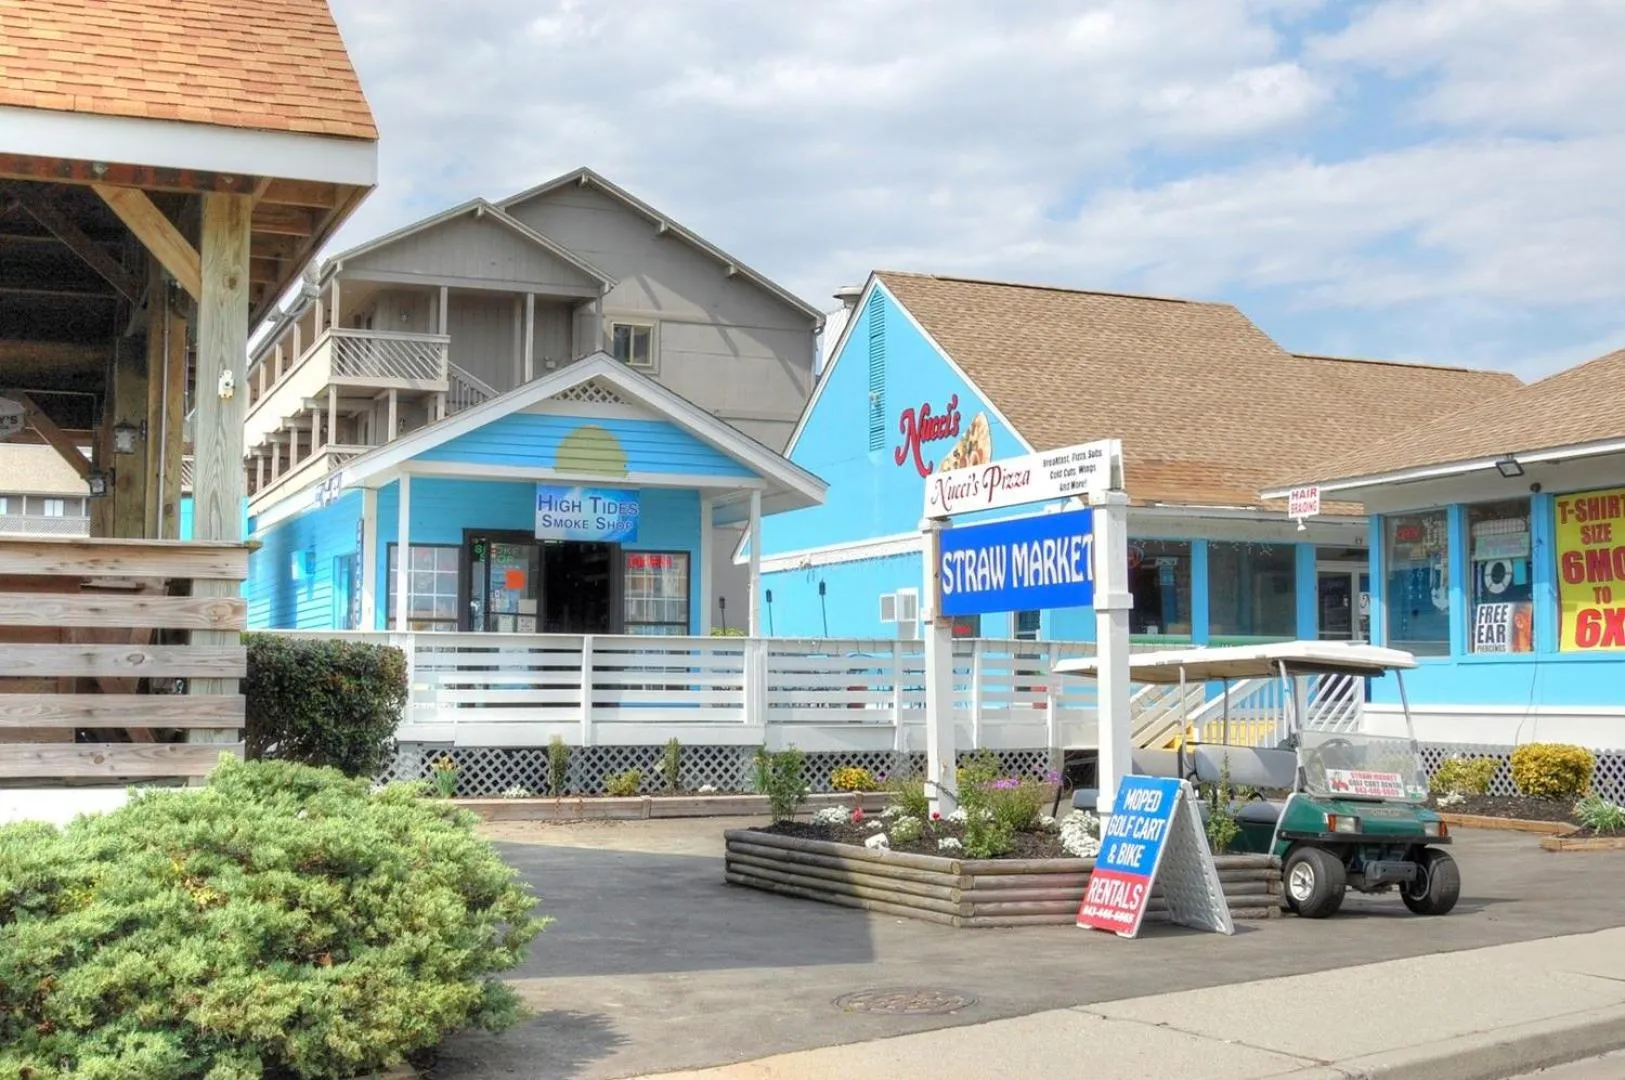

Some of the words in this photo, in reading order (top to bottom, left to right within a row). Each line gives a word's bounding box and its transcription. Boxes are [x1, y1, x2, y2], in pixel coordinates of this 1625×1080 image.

[894, 393, 961, 479] Nucci's
[930, 472, 980, 512] Nucci's
[982, 465, 1031, 503] Pizza
[1291, 487, 1317, 499] HAIR
[538, 494, 582, 513] HIGH
[589, 496, 639, 516] TIDES
[542, 514, 588, 529] SMOKE
[595, 517, 632, 530] SHOP
[1580, 522, 1612, 546] SIZE
[942, 544, 1007, 595] STRAW
[1012, 533, 1093, 588] MARKET
[1592, 585, 1612, 605] TO
[1478, 604, 1509, 624] FREE
[1477, 624, 1506, 644] EAR
[1124, 789, 1164, 813] MOPED
[1108, 815, 1134, 837] GOLF
[1133, 817, 1165, 841] CART
[1107, 844, 1117, 864] &
[1117, 844, 1146, 867] BIKE
[1088, 876, 1144, 911] RENTALS
